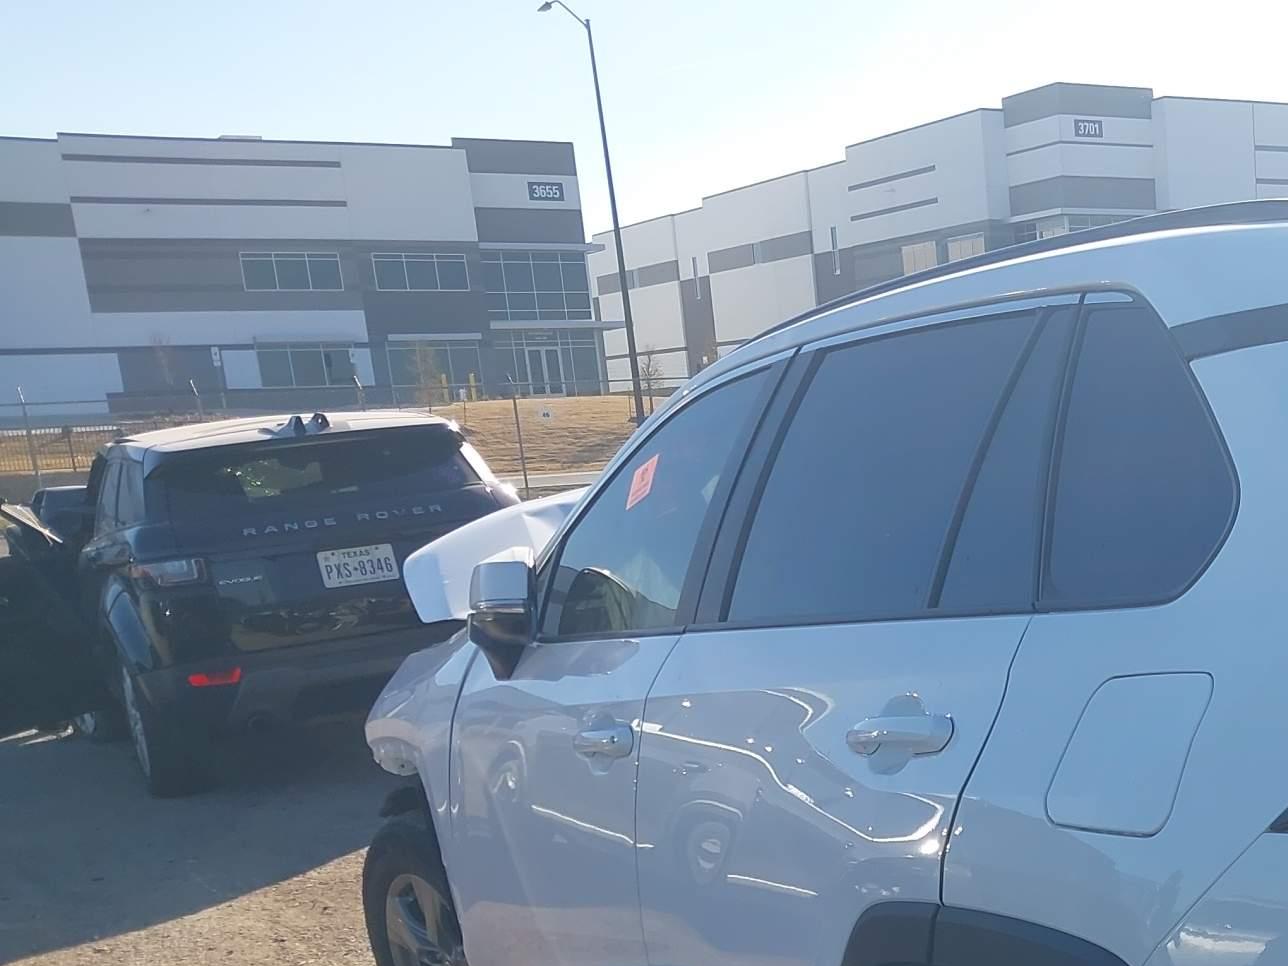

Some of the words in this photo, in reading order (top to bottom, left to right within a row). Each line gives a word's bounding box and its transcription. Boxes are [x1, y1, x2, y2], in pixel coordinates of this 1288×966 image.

[1078, 122, 1099, 135] 3701
[532, 185, 560, 198] 3655
[242, 516, 337, 536] RANGE
[357, 503, 442, 521] ROVER
[341, 550, 370, 559] TEXAS
